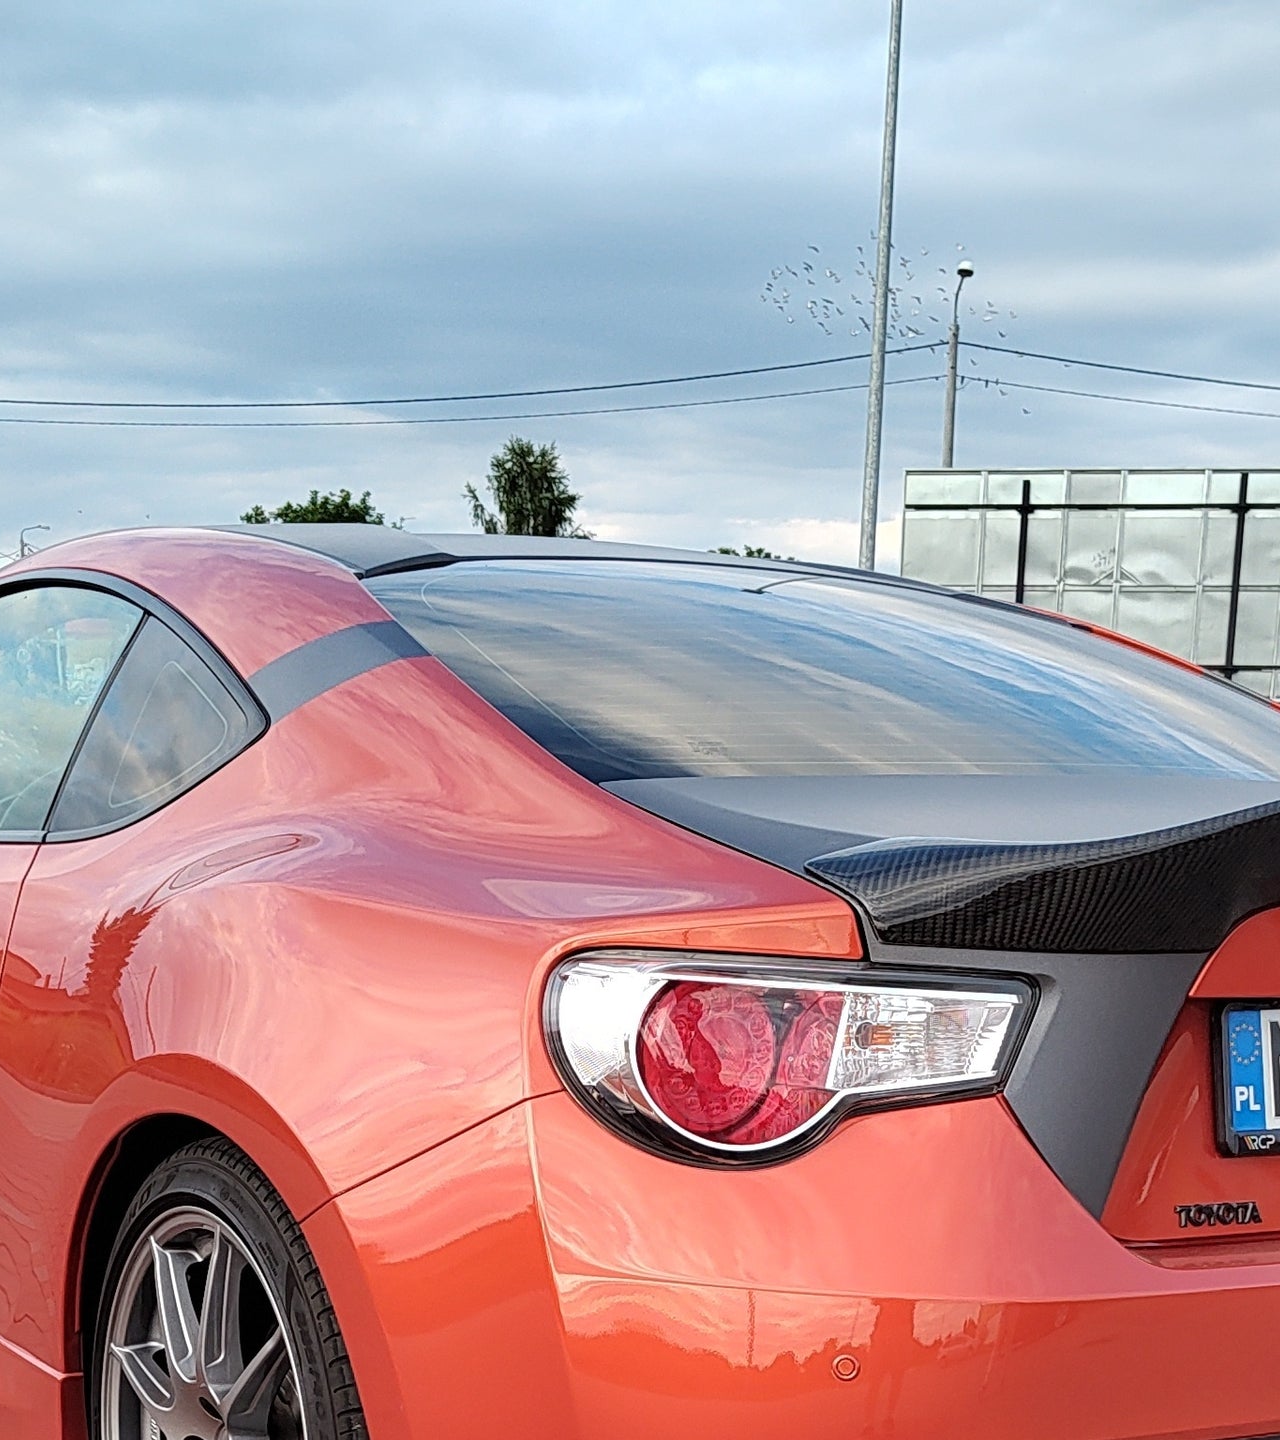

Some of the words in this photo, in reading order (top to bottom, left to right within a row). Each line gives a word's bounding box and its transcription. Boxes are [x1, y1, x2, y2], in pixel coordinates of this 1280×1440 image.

[1235, 1085, 1262, 1112] PL
[1251, 1134, 1276, 1150] RCP
[1174, 1201, 1263, 1228] TOYOTA
